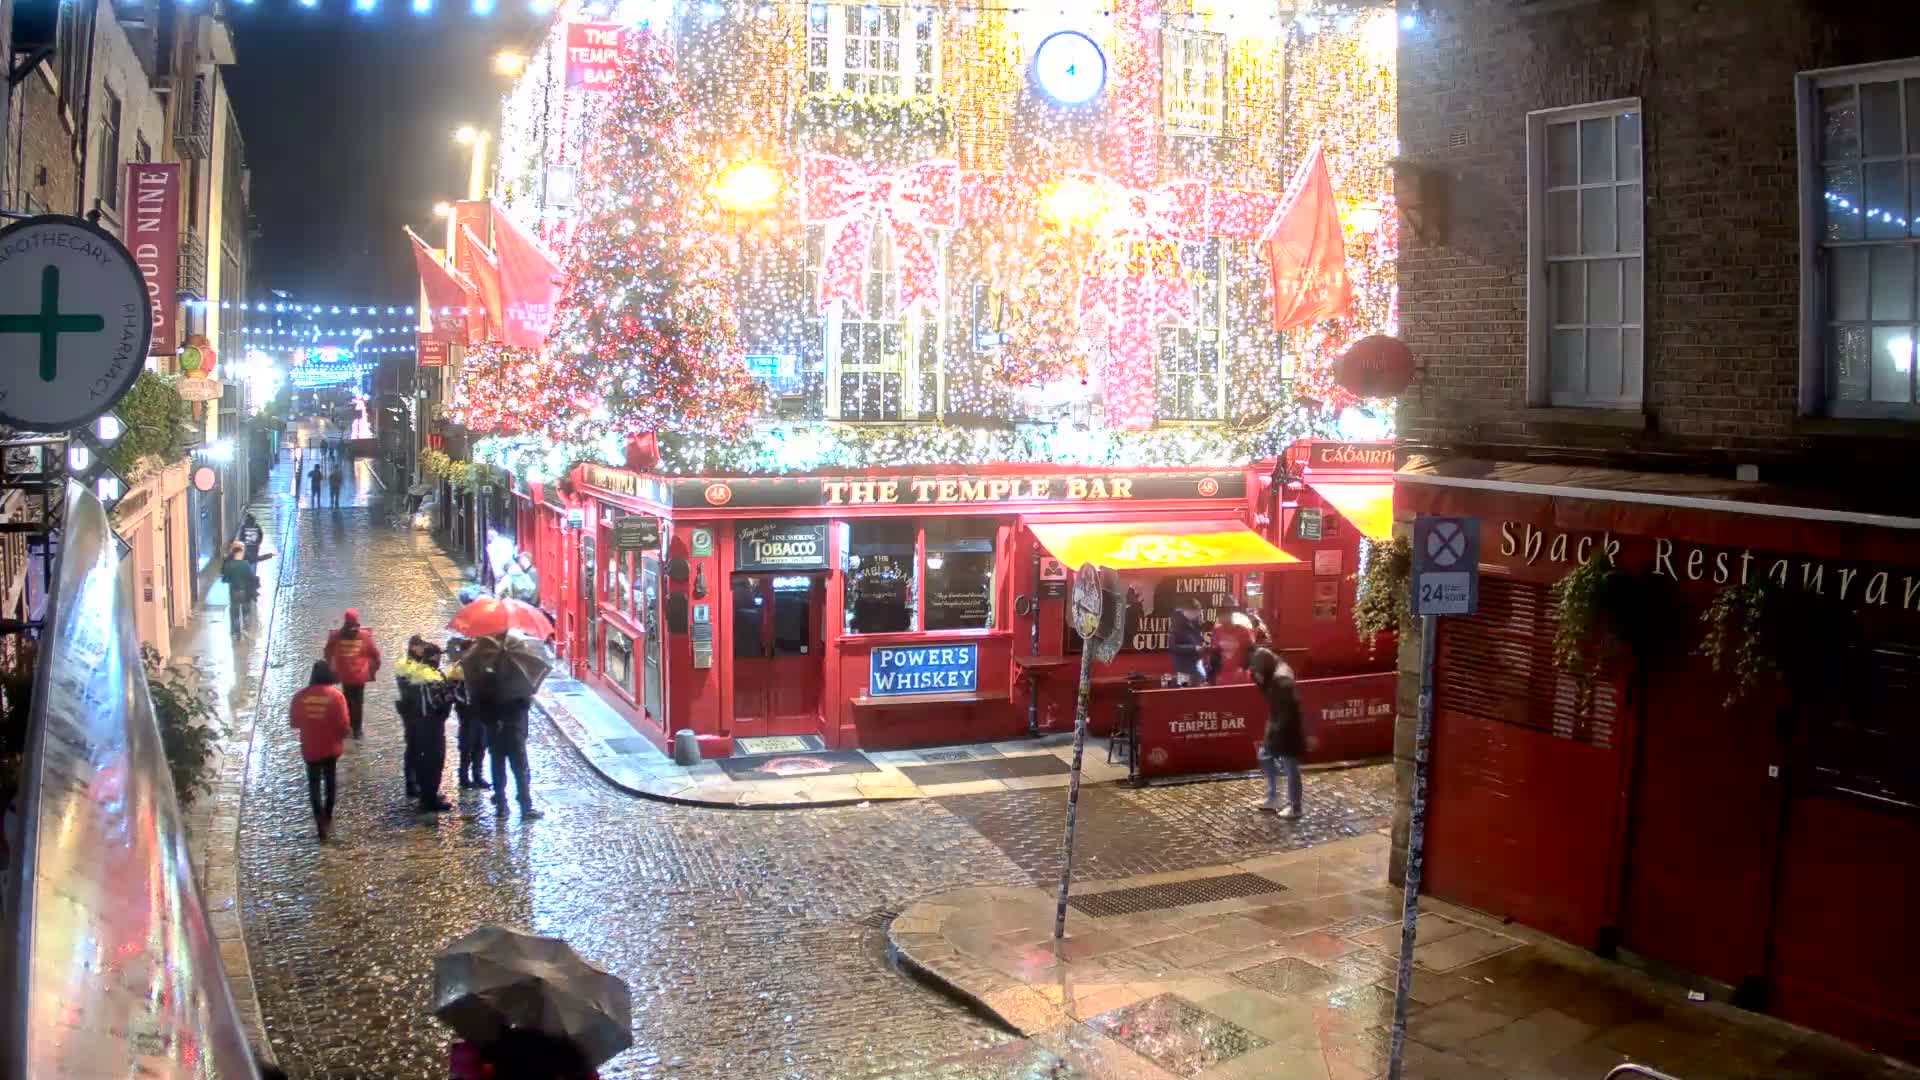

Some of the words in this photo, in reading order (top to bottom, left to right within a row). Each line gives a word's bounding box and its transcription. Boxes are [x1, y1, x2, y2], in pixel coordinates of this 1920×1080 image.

[584, 29, 618, 46] THE
[568, 46, 625, 64] TEMPL
[137, 171, 168, 232] NINE
[90, 303, 137, 401] PHARMACY
[823, 480, 899, 504] THE
[912, 478, 1050, 503] TEMPLE
[1066, 477, 1133, 499] BAR
[750, 539, 816, 561] TOBACCO
[1501, 520, 1620, 567] Shack
[1422, 583, 1442, 602] 24
[880, 647, 970, 668] POWER'S
[873, 670, 974, 690] WHISKEY
[1168, 720, 1218, 733] TEMPLE
[1221, 717, 1246, 729] BAR
